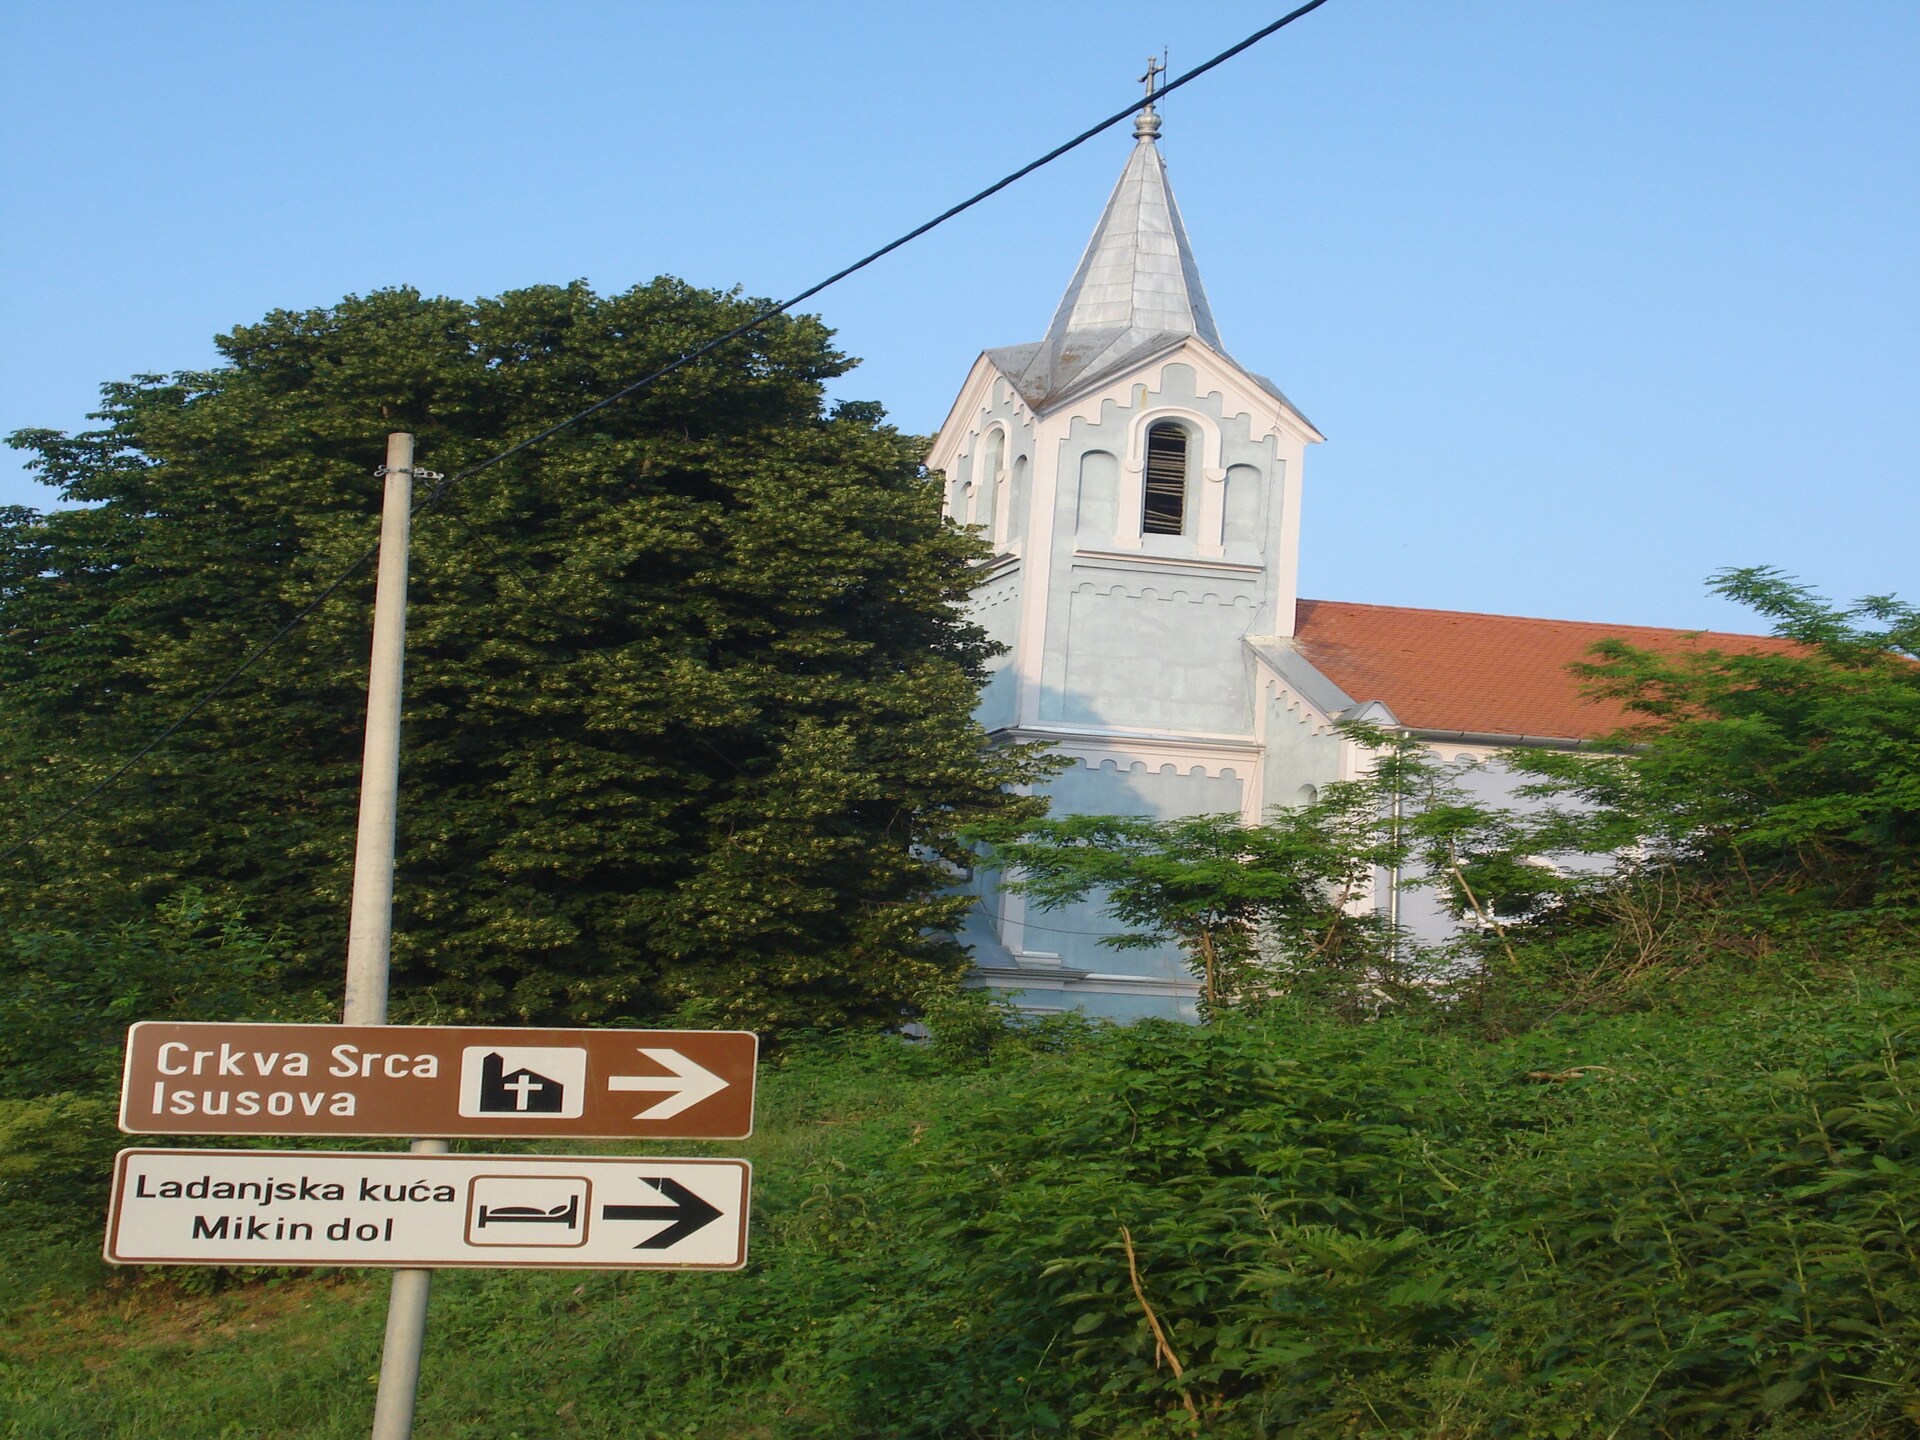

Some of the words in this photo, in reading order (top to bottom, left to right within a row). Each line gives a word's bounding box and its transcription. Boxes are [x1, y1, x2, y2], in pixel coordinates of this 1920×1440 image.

[157, 1041, 309, 1077] Crkva
[328, 1044, 438, 1078] Srca
[152, 1081, 356, 1117] Isusova
[135, 1174, 345, 1207] Ladanjska
[359, 1177, 456, 1203] kuća
[192, 1215, 313, 1241] Mikin
[326, 1217, 394, 1242] dol
